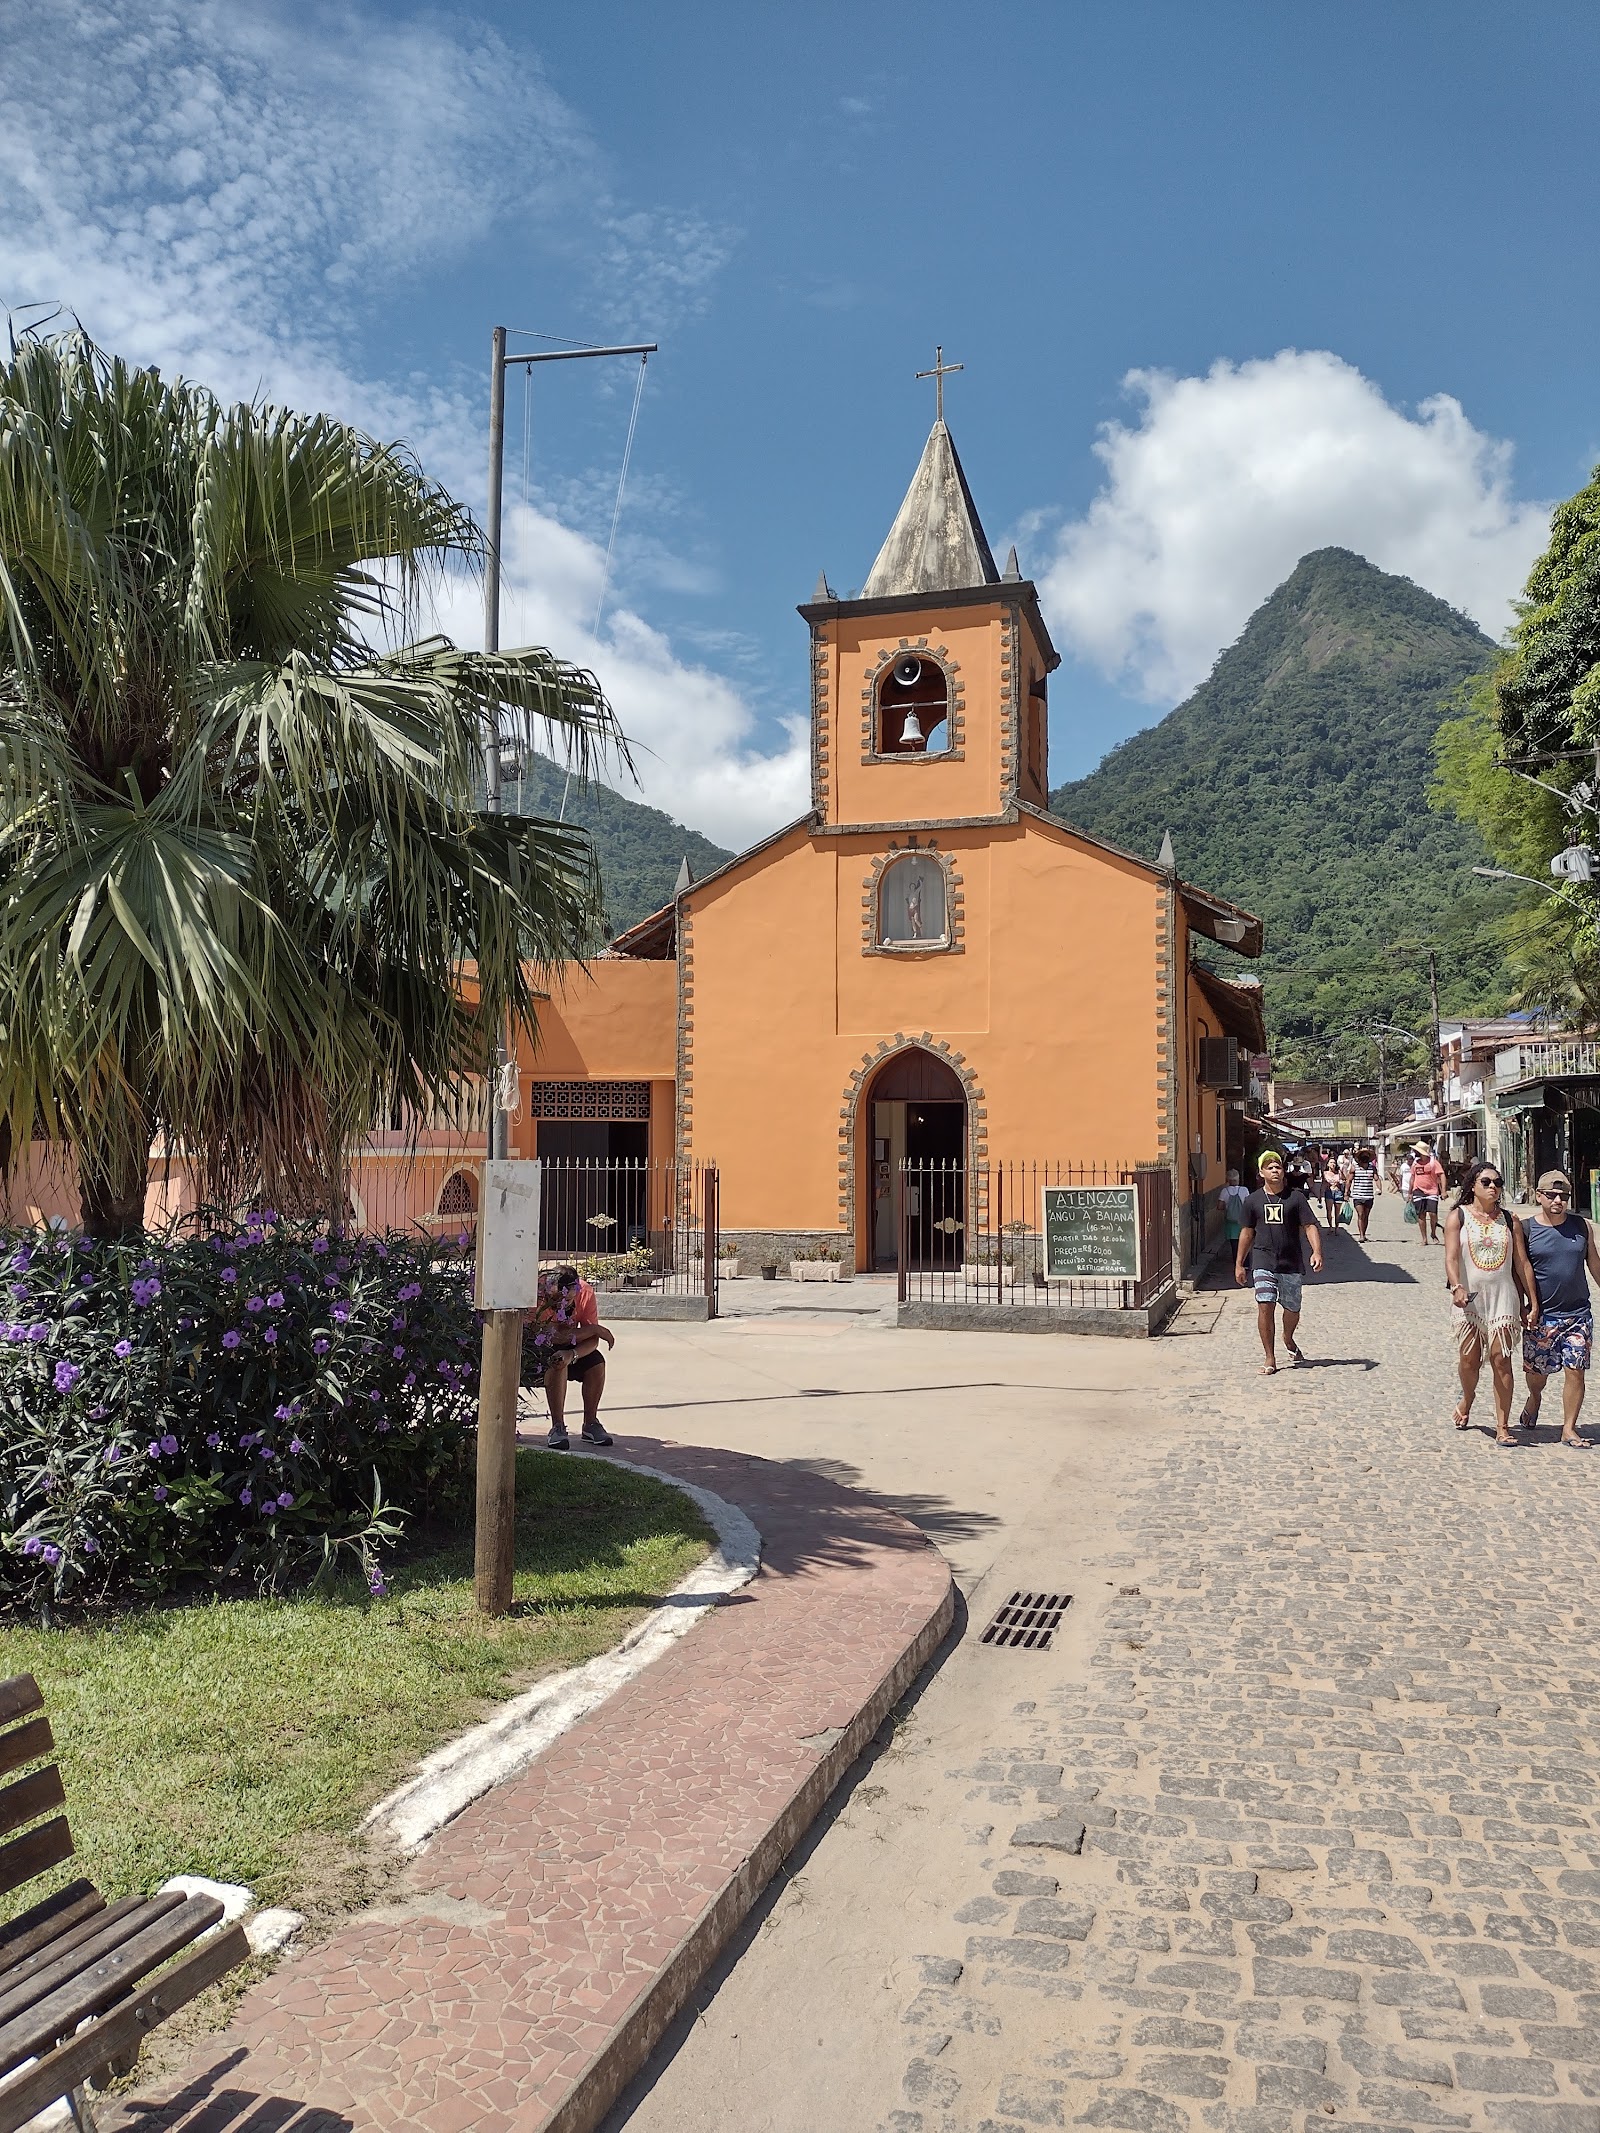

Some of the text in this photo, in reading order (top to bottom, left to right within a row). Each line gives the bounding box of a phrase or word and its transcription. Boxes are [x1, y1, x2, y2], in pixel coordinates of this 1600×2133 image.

[1312, 1120, 1320, 1128] DA
[1320, 1119, 1334, 1128] ILHA
[1056, 1191, 1128, 1205] ATENÇÃO
[1082, 1209, 1091, 1220] À
[1054, 1256, 1086, 1265] INCLUÍDO
[1076, 1265, 1127, 1273] REFRIGERANTE
